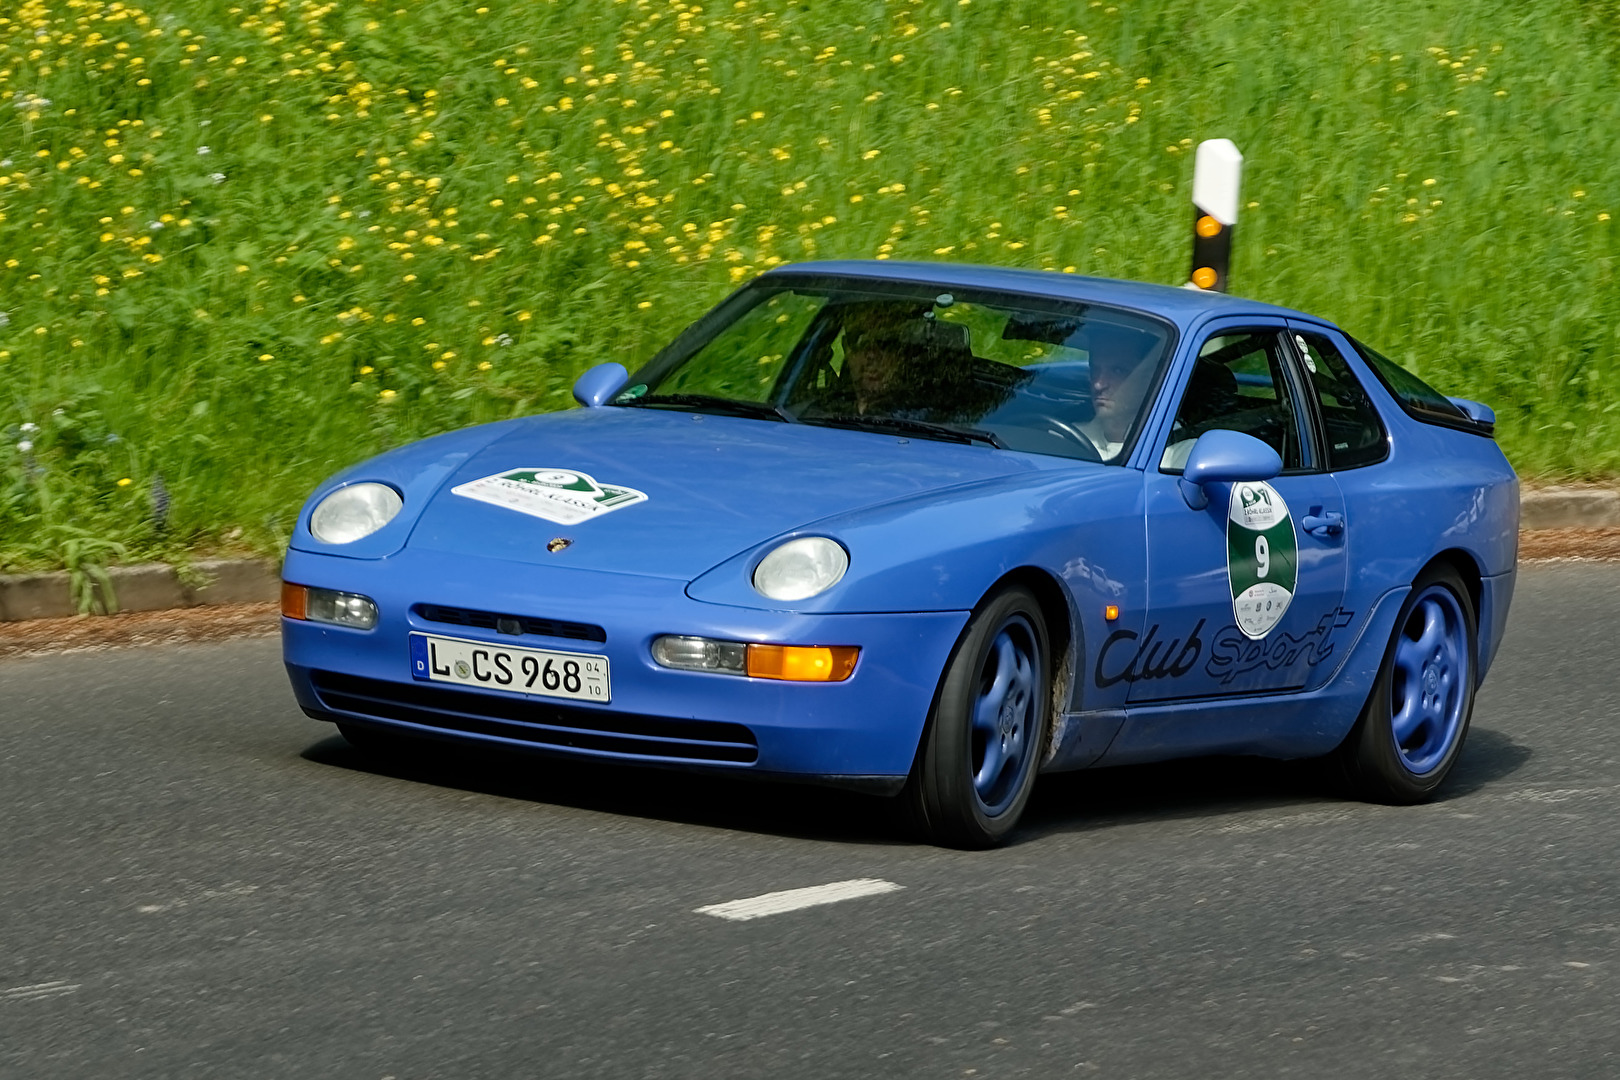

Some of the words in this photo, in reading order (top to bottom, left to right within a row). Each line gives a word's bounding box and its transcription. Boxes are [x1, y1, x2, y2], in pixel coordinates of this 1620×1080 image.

[1255, 535, 1270, 579] 9
[1094, 617, 1206, 689] Club
[1205, 606, 1355, 685] Sport
[417, 660, 425, 671] D
[430, 642, 450, 676] L
[472, 649, 513, 685] CS
[521, 656, 581, 693] 968
[586, 661, 600, 673] 04
[588, 684, 601, 695] 10
